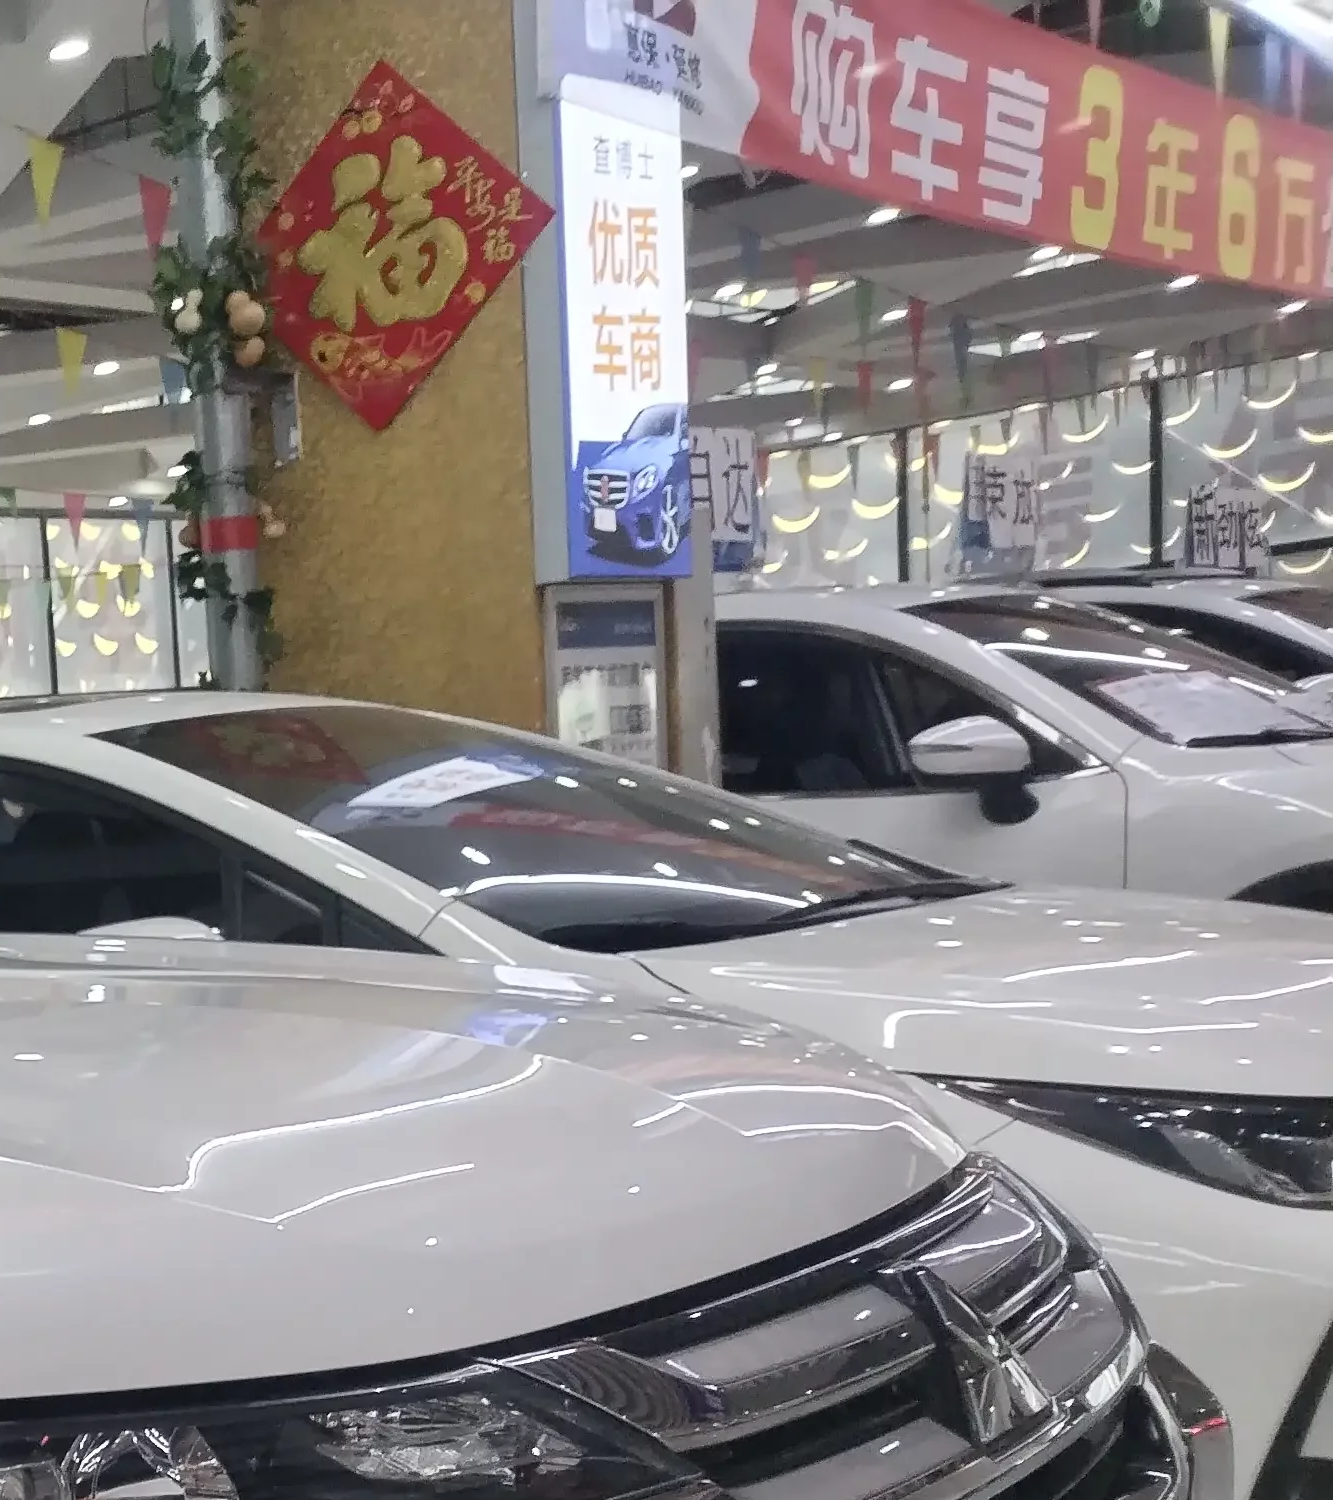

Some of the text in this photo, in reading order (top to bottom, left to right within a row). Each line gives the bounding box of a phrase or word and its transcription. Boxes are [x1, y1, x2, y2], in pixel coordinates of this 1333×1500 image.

[789, 0, 1333, 288] 购车享3年6万
[297, 135, 469, 332] 福
[589, 198, 660, 288] 优质
[591, 305, 664, 393] 车商
